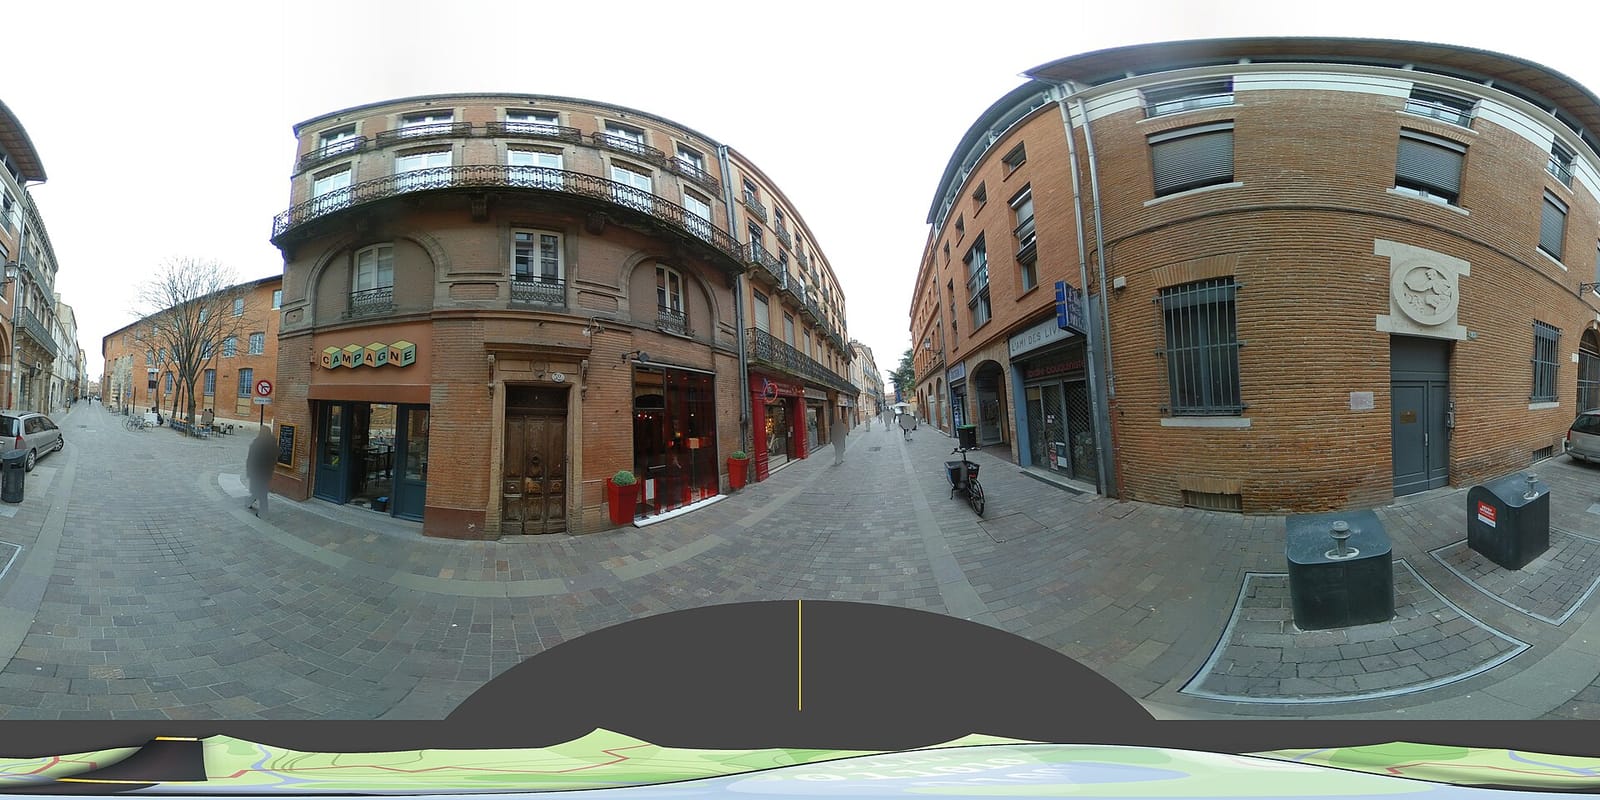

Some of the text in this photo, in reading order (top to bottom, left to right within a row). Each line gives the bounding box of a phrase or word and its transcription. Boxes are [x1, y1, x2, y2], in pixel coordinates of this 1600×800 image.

[1028, 331, 1041, 345] DES
[1045, 326, 1057, 338] LIV
[322, 350, 413, 365] CAMPAGNE
